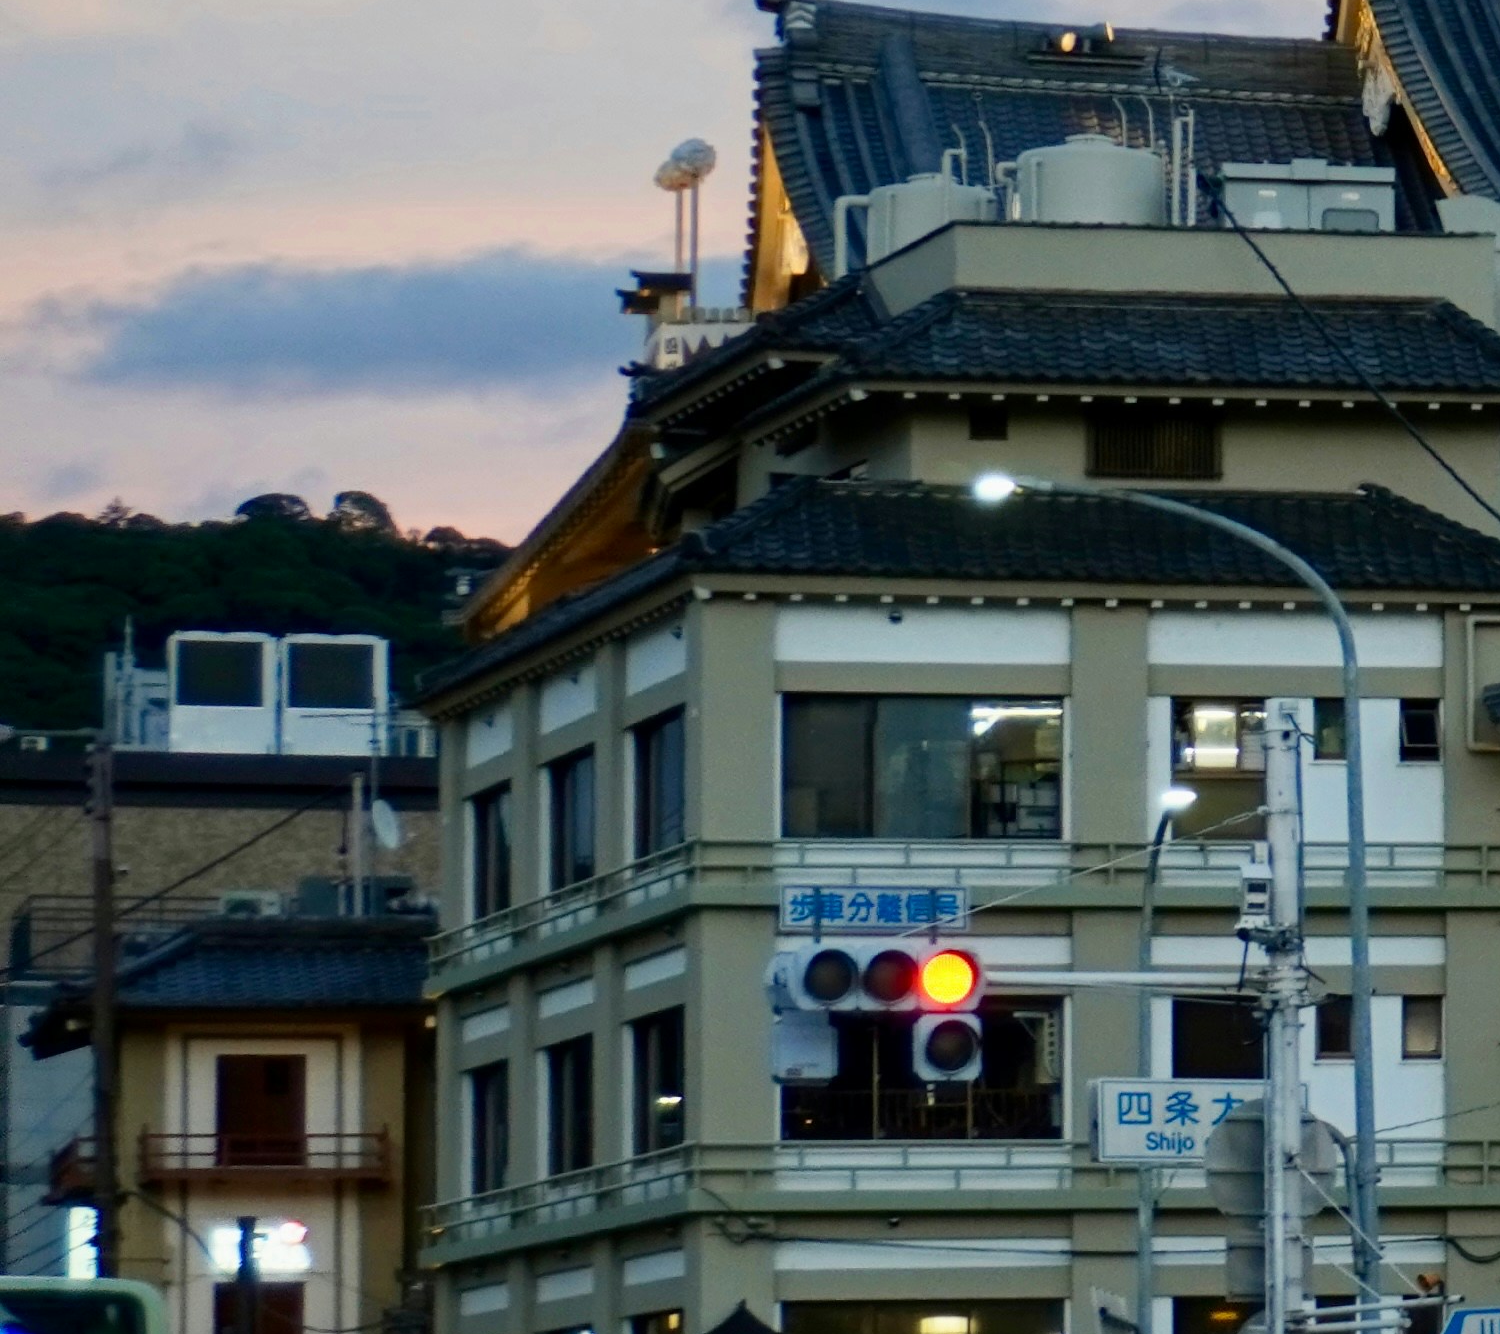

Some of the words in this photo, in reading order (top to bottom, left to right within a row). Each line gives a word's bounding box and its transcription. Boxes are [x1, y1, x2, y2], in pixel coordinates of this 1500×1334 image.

[789, 892, 960, 924] 歩車分離信号
[1117, 1091, 1244, 1126] 四条大
[1145, 1131, 1195, 1154] Shijo
